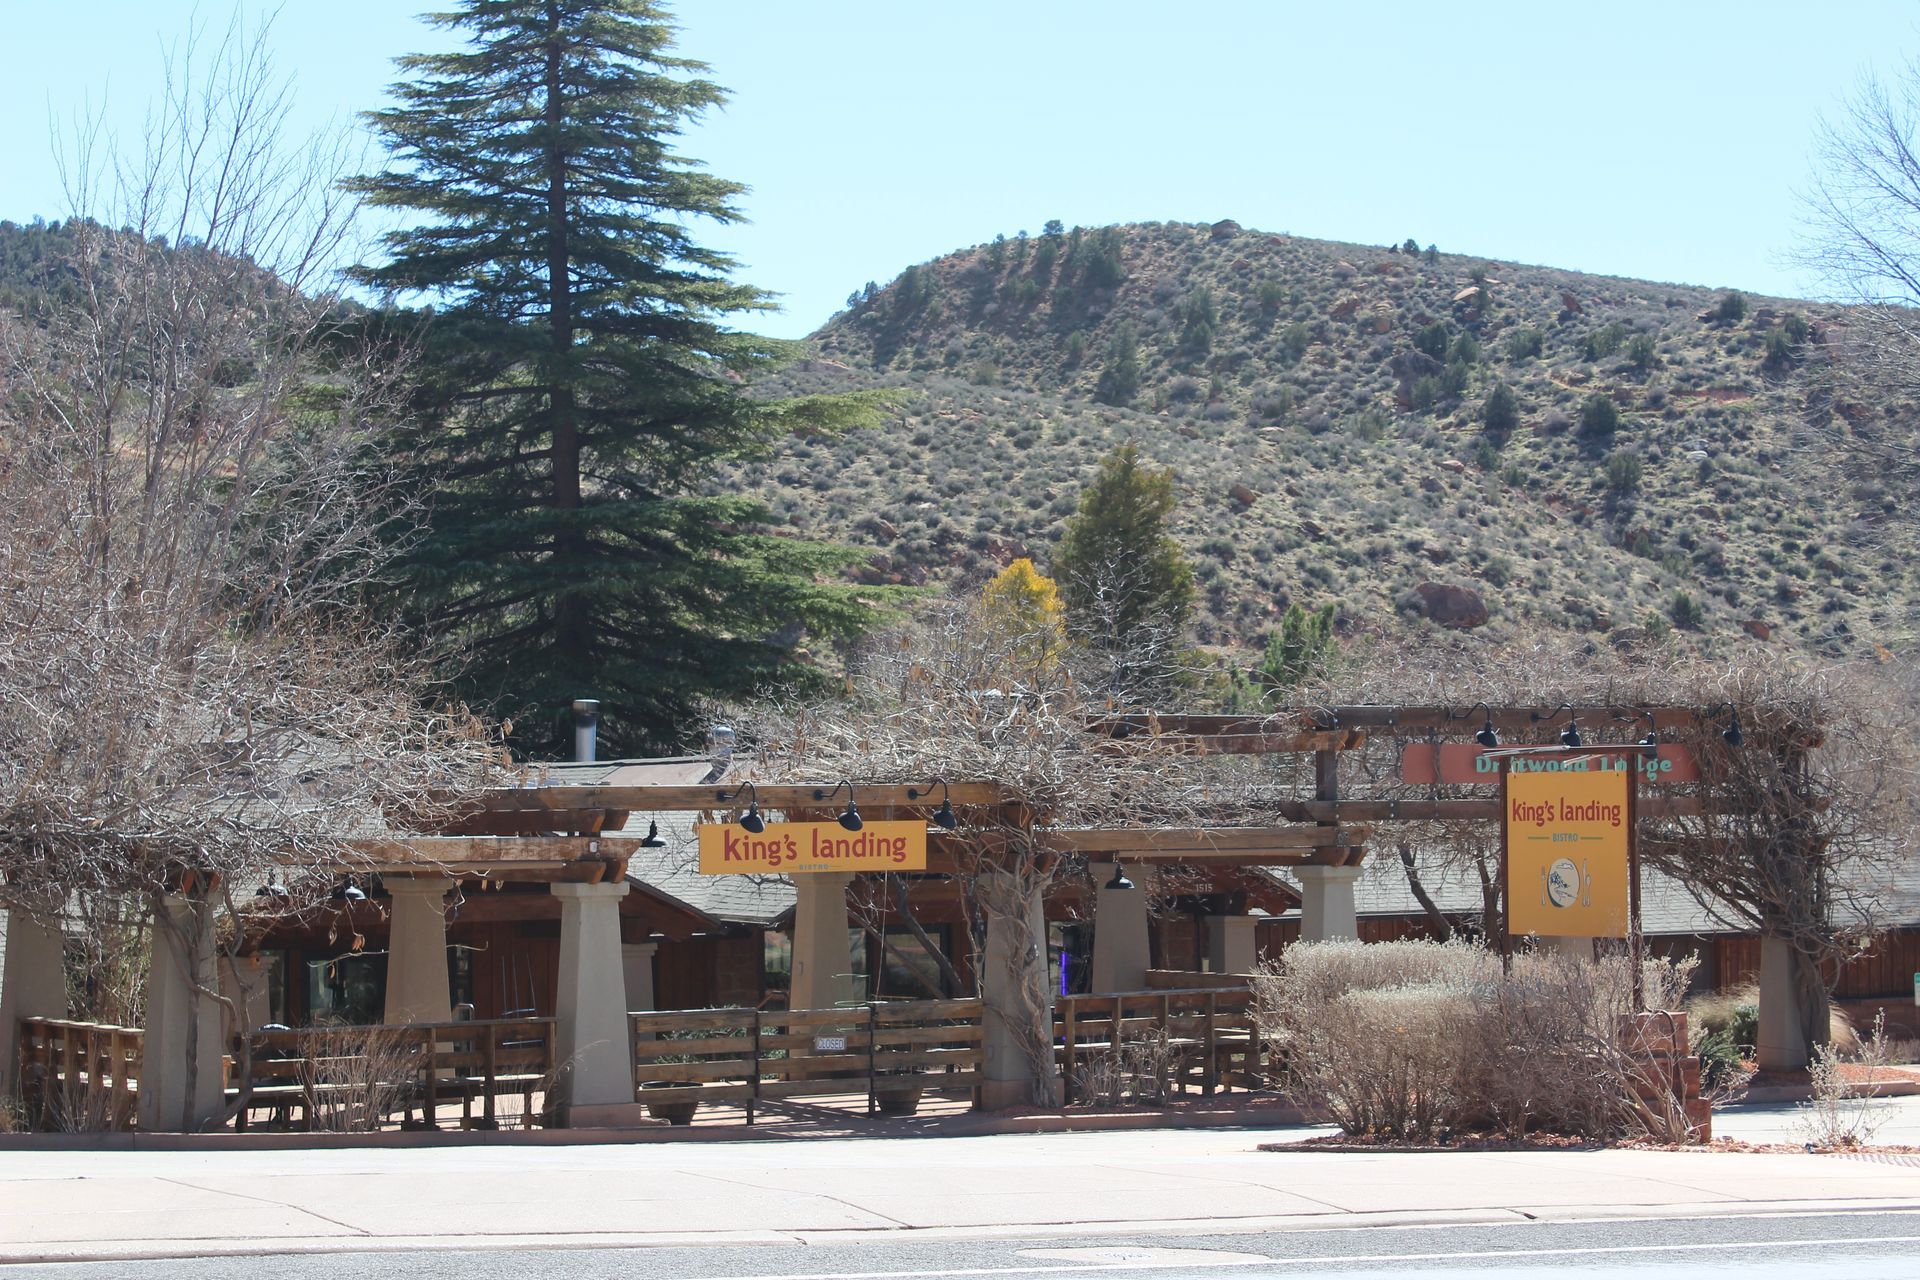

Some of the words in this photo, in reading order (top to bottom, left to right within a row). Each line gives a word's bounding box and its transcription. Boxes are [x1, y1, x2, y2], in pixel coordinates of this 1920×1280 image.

[1476, 754, 1589, 773] Drftwood
[1512, 798, 1555, 827] king's
[1560, 797, 1621, 827] landing
[1552, 833, 1578, 842] BISTRO
[723, 828, 798, 866] king's
[811, 827, 907, 863] landing
[1196, 883, 1213, 892] 1515
[818, 1039, 844, 1048] CLOSED
